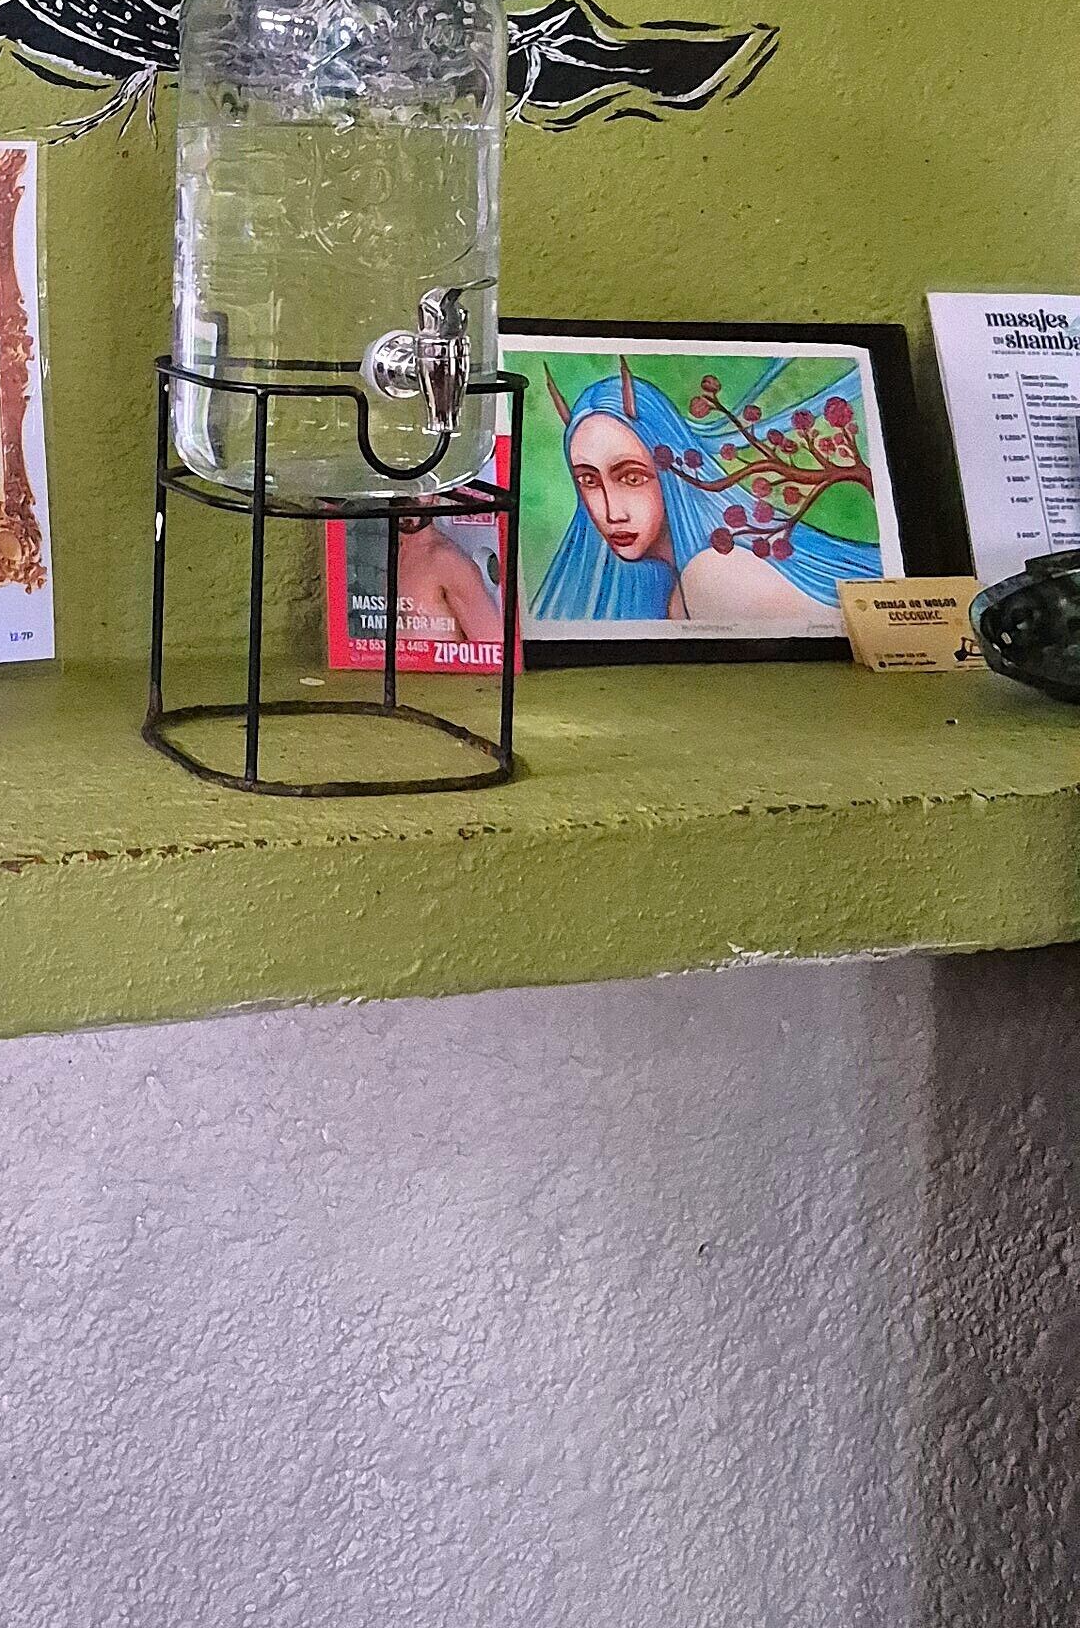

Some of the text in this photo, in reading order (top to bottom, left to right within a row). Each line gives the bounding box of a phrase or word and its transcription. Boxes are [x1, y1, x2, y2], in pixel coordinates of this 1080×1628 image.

[985, 309, 1069, 333] masajes
[352, 595, 414, 612] MASSES
[360, 614, 404, 630] TANTA
[406, 615, 428, 630] FOR
[434, 642, 502, 665] ZIPOLITE
